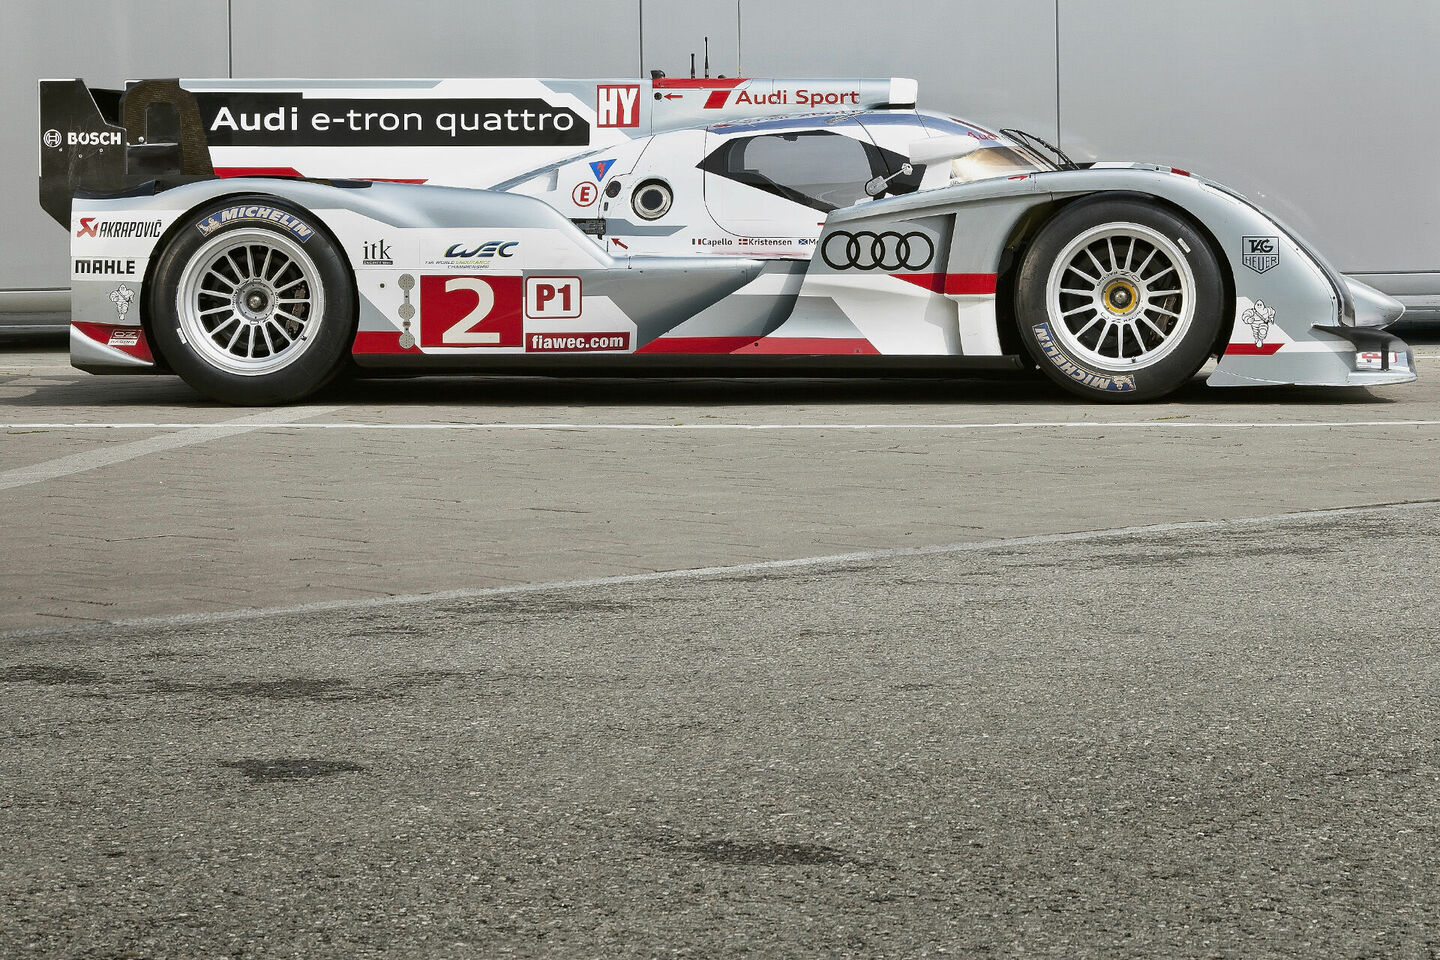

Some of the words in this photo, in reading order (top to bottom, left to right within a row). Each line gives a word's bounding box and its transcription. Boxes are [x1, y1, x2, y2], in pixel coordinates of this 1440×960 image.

[598, 87, 639, 125] HY
[735, 90, 787, 105] Audi
[795, 89, 860, 108] Sport
[210, 106, 298, 131] Audi
[311, 109, 422, 131] e-tron
[435, 109, 574, 137] quattro
[67, 131, 122, 145] BOSCH
[579, 186, 591, 202] E
[99, 219, 162, 238] AKRAPOVIČ
[221, 206, 312, 237] MICHELIN
[362, 239, 392, 259] itk
[443, 241, 519, 258] WEC
[702, 238, 733, 247] Capello
[748, 238, 793, 246] Kristensen
[1248, 239, 1274, 253] TAG
[75, 260, 136, 274] MAHLE
[1245, 256, 1277, 271] HEUER
[536, 283, 571, 312] P1
[442, 277, 501, 344] 2
[531, 334, 624, 349] fiawec.com
[1035, 327, 1110, 390] MICHELIN
